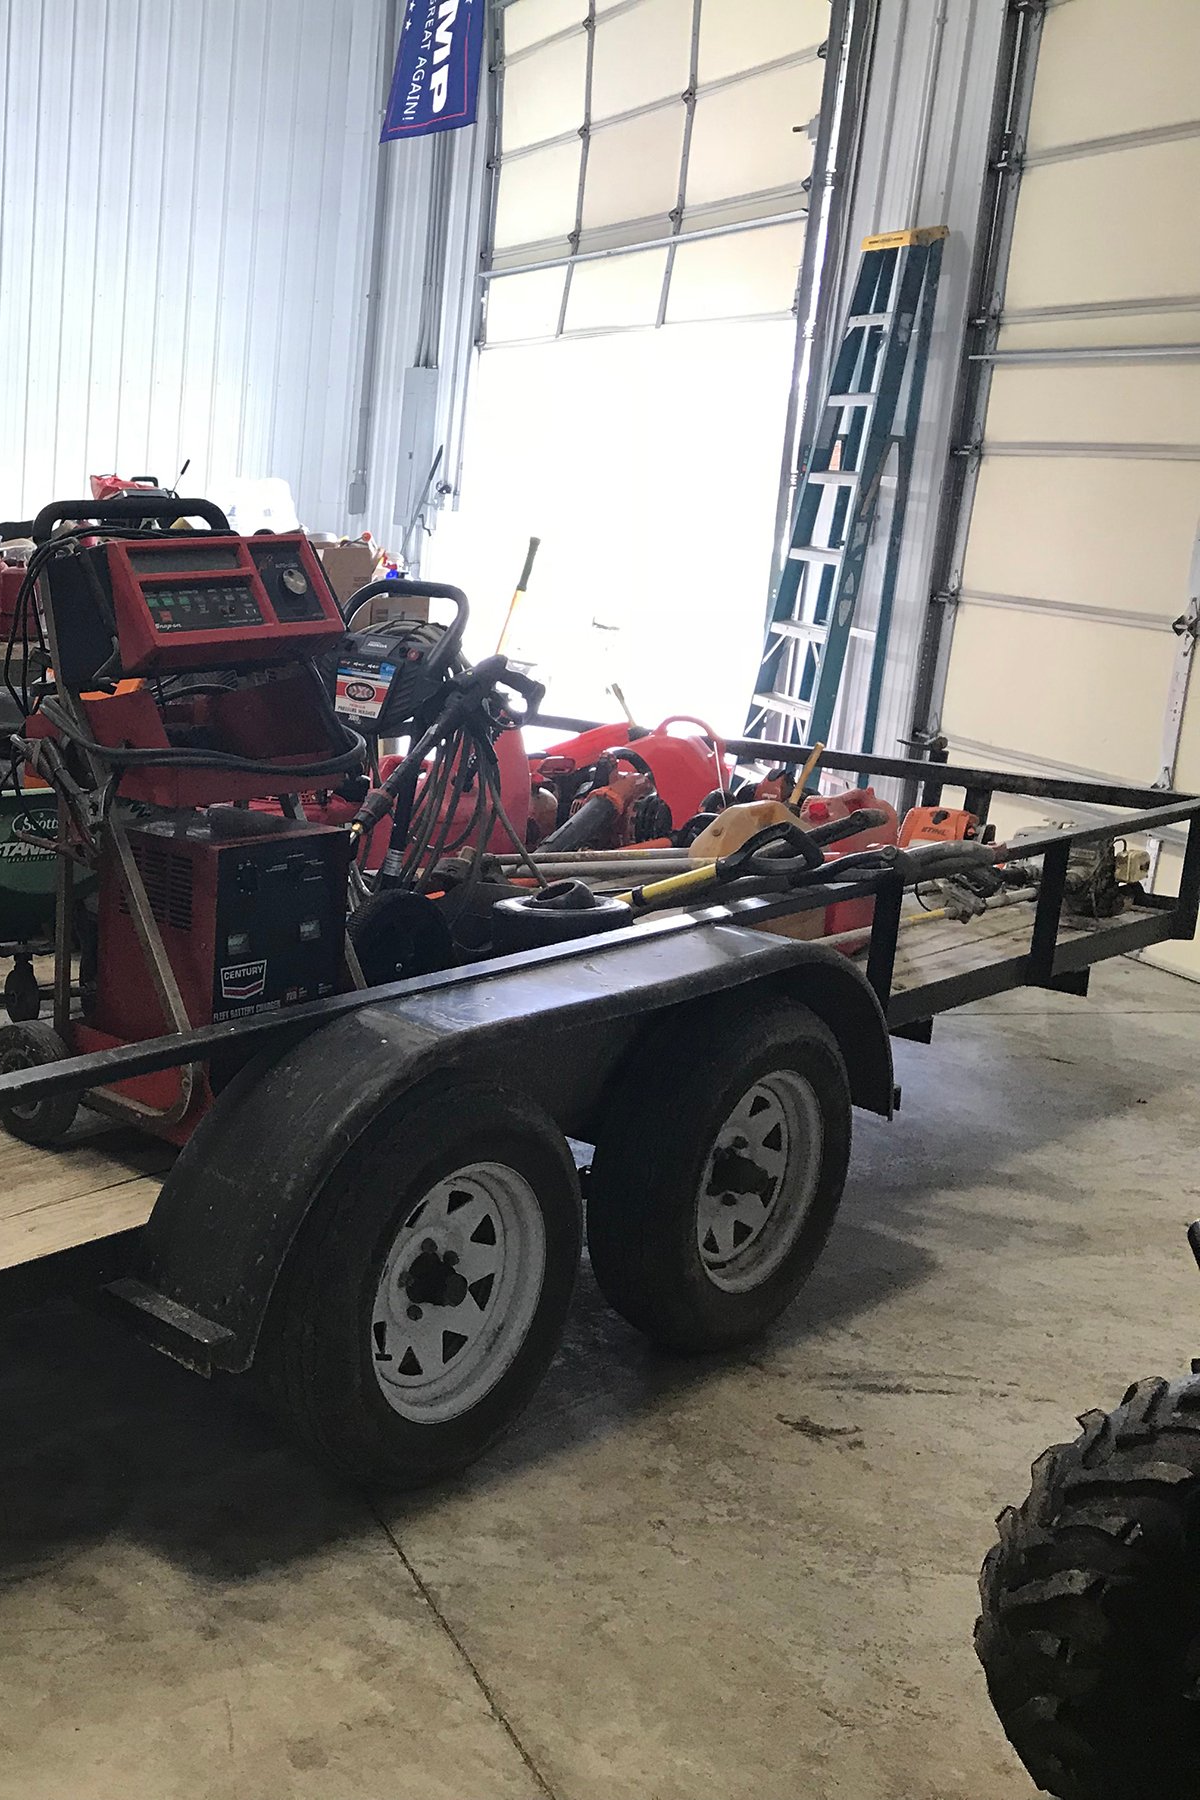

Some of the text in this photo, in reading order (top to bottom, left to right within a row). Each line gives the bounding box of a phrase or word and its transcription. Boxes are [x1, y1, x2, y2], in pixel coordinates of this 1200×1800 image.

[402, 57, 428, 120] AGAIN!
[22, 816, 59, 831] Sott
[224, 965, 264, 980] CENTURY
[230, 1005, 255, 1018] BATTERY
[256, 1000, 280, 1013] CHARGER
